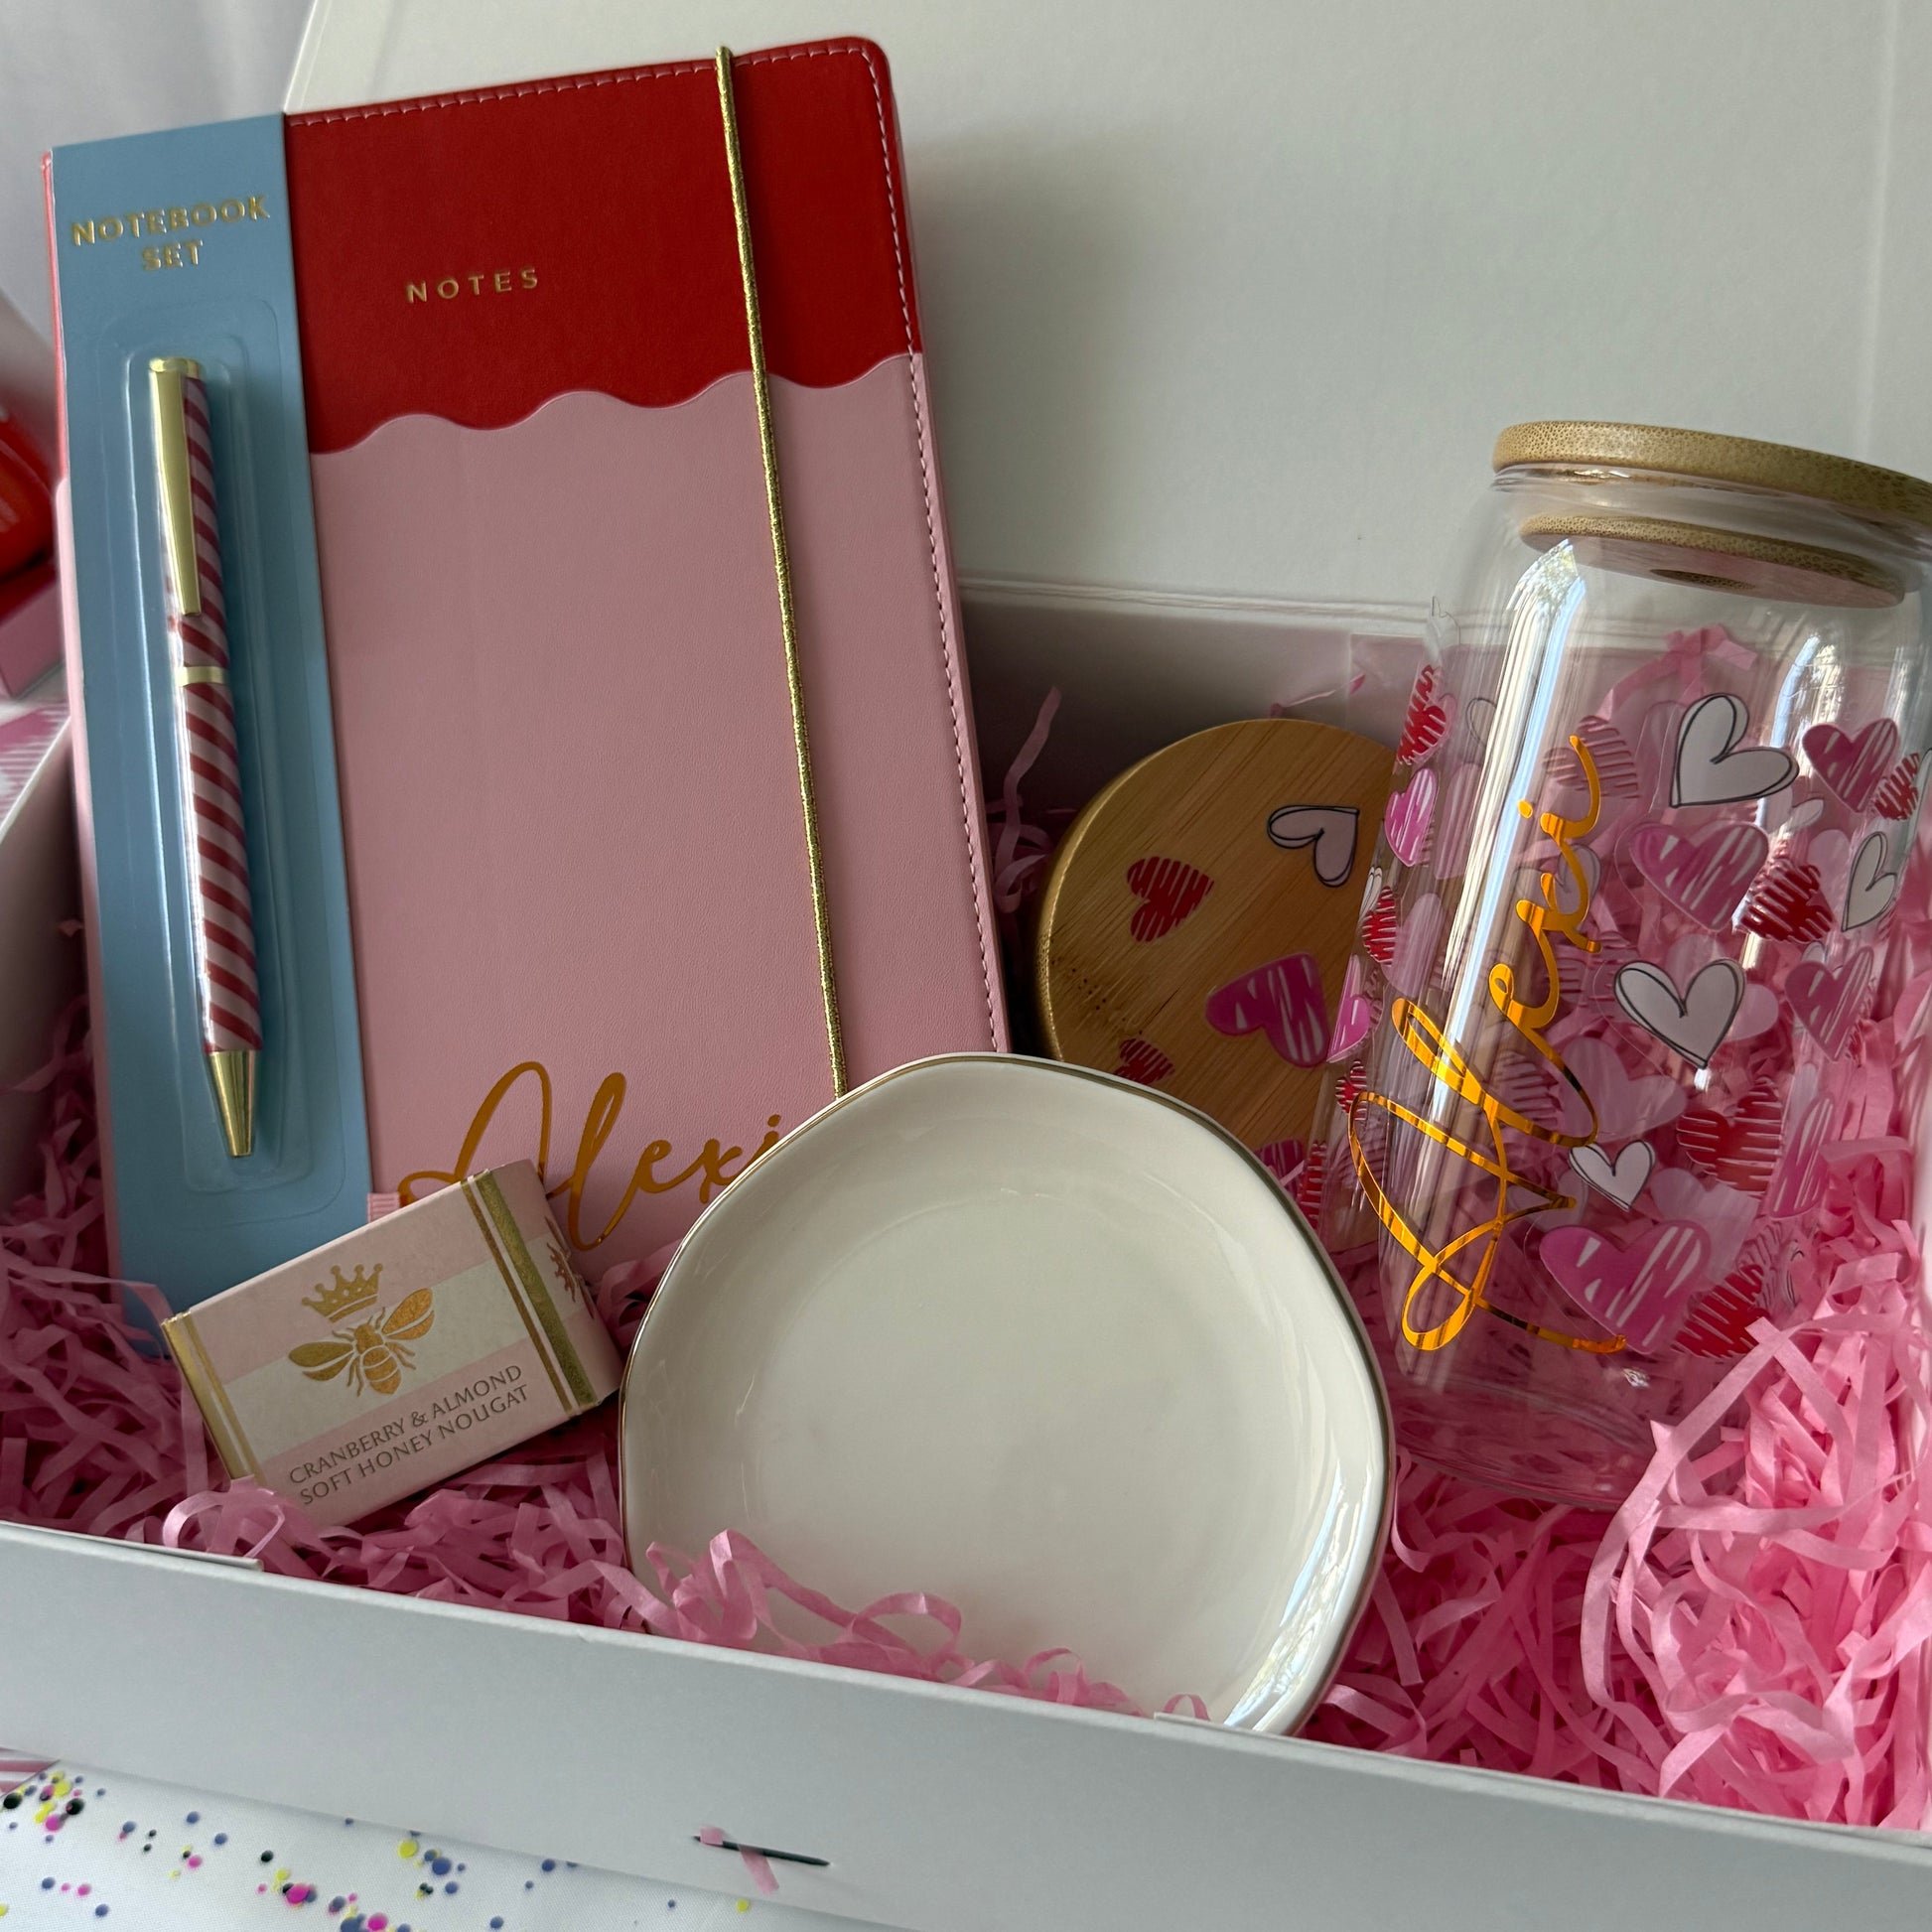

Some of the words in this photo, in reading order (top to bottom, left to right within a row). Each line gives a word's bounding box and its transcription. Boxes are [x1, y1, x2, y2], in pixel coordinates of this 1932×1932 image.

[71, 195, 271, 247] NOTEBOOK
[141, 239, 205, 272] SET
[405, 266, 540, 305] NOTES
[288, 1417, 406, 1485] CRANBERRY
[411, 1410, 429, 1428] &
[432, 1364, 523, 1420] ALMOND
[299, 1467, 353, 1506] SOFT
[357, 1429, 434, 1478] HONEY
[438, 1383, 529, 1441] NOUGAT
